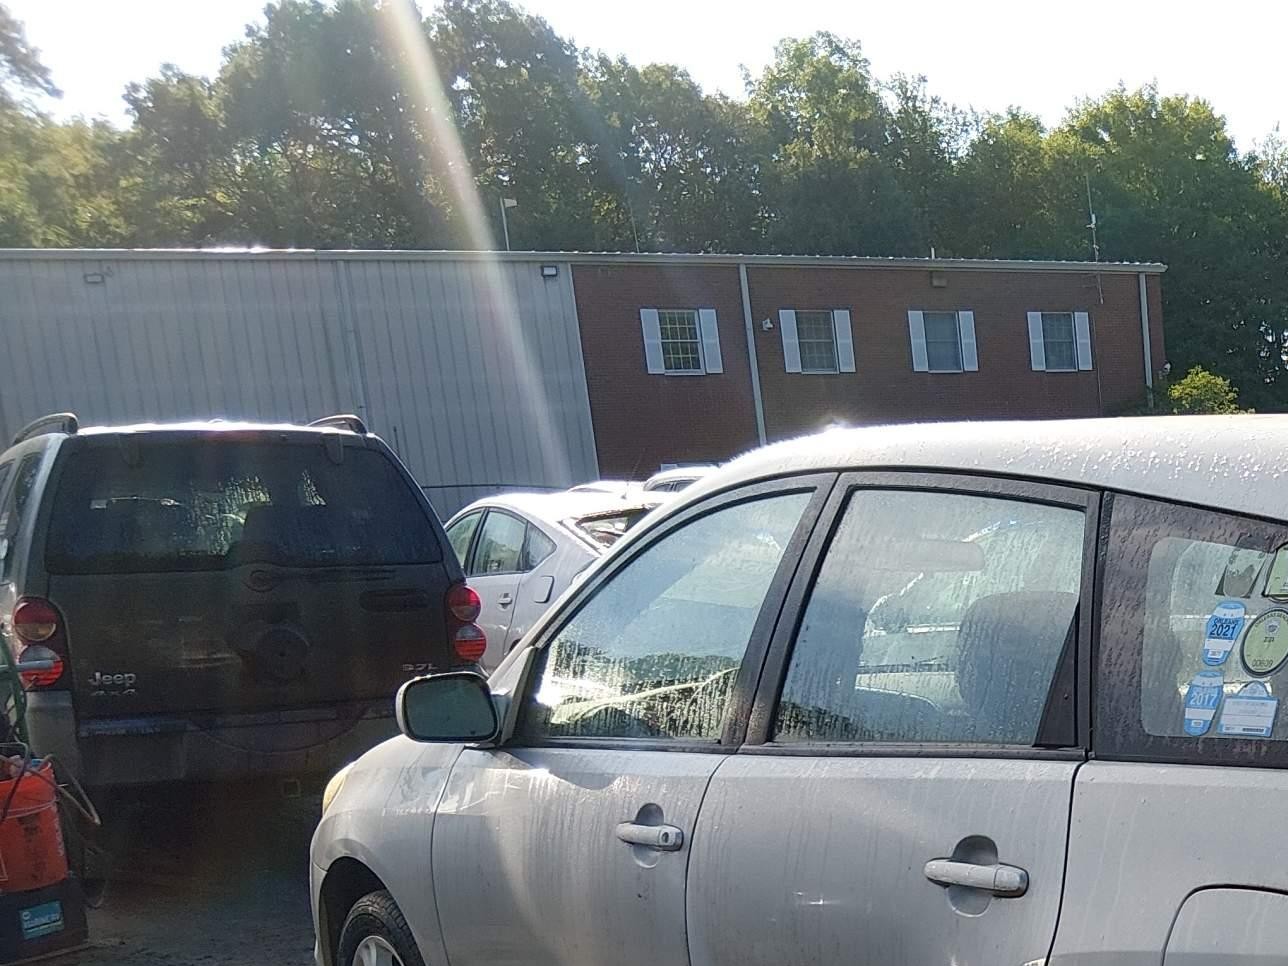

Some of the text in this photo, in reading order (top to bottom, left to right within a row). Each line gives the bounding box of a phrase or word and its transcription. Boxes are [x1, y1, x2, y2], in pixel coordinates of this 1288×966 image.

[1208, 623, 1238, 638] 2021
[88, 671, 137, 688] Jeep
[1189, 693, 1217, 707] 2017
